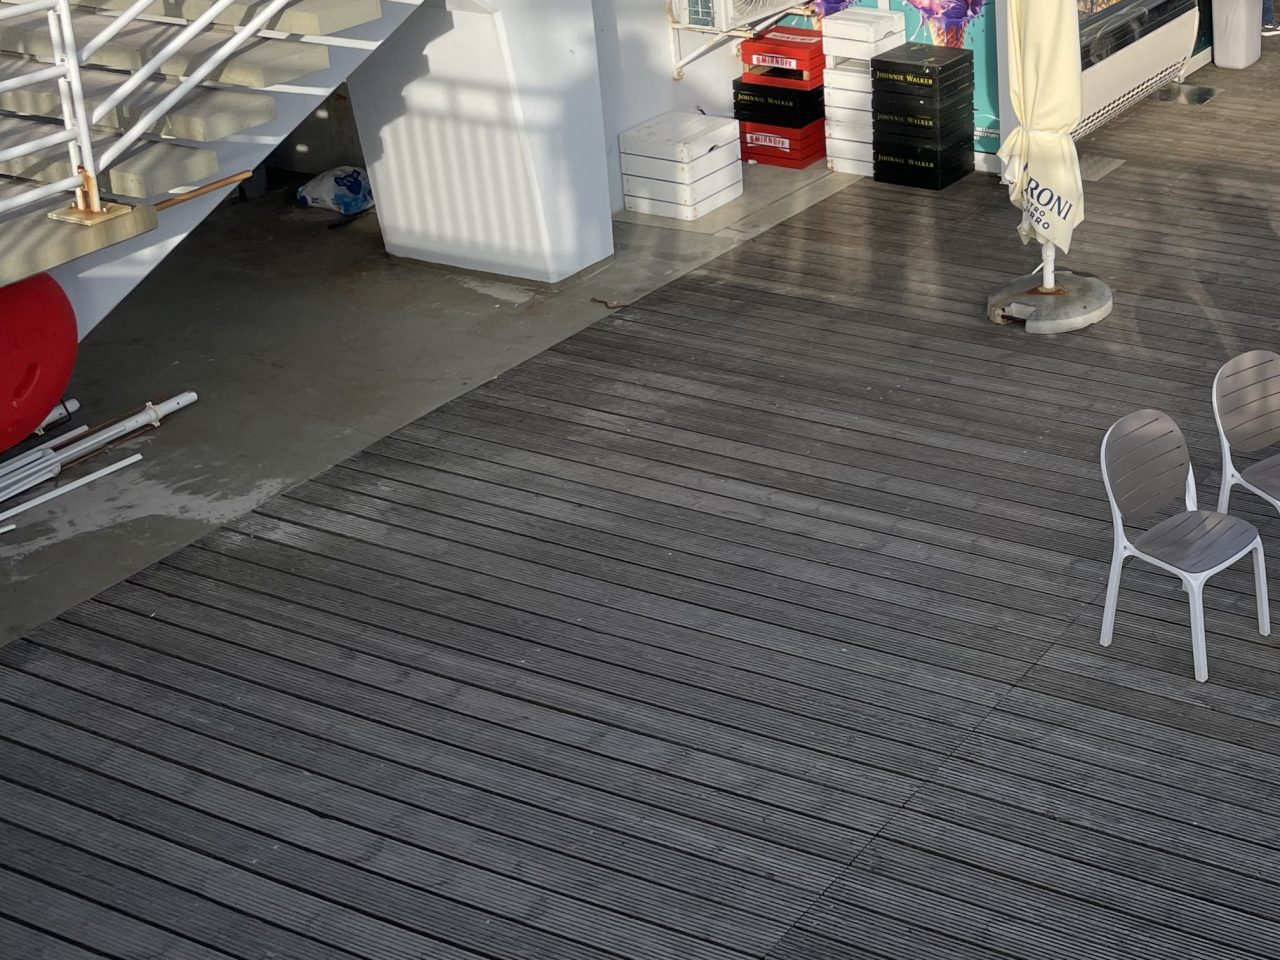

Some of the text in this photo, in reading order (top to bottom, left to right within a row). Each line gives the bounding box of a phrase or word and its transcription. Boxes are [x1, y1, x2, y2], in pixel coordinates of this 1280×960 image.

[756, 55, 793, 68] SMIRNOFF
[876, 71, 933, 85] JOHNNIE WALKER
[738, 93, 794, 107] JOHNNIE WALKER
[877, 113, 934, 127] JOHNNIE WALKER
[749, 134, 786, 147] SMIRNOFF
[878, 153, 934, 168] JOHNNIE WALKER
